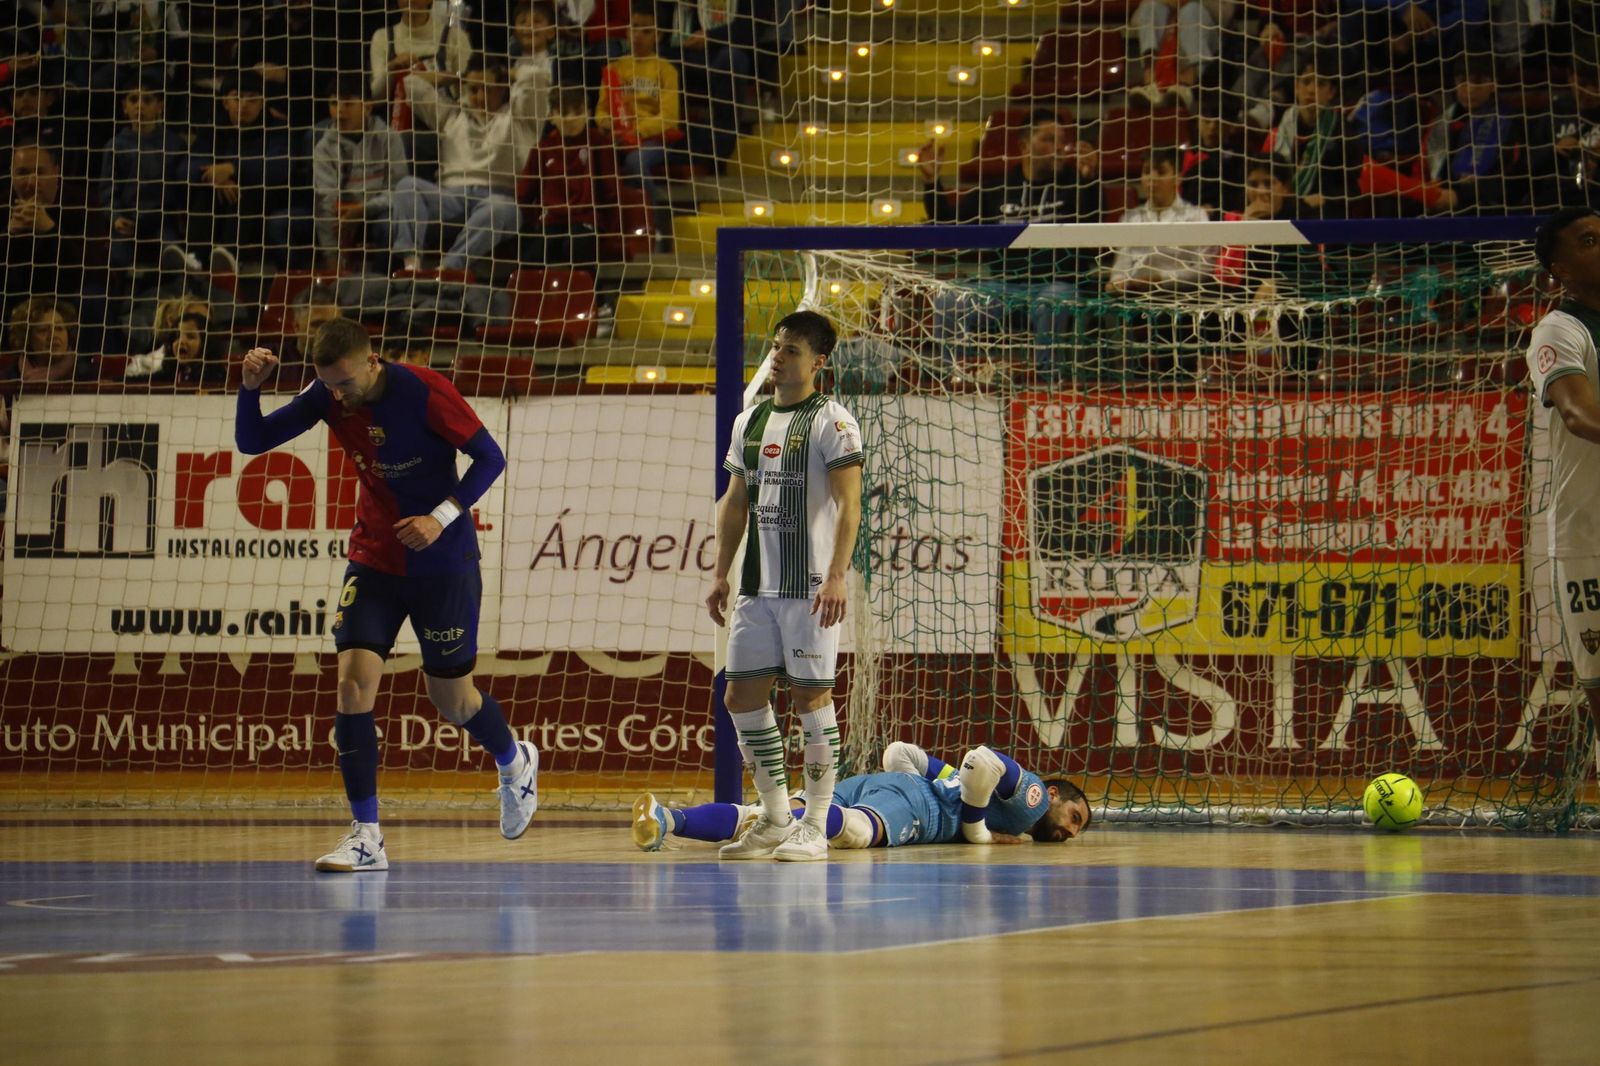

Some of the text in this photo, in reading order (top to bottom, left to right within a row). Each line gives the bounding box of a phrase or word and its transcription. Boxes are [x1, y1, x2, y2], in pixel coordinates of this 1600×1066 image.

[1485, 404, 1509, 438] 4
[168, 538, 319, 558] INSTALACIONES
[1044, 567, 1190, 593] RUTA
[1566, 578, 1600, 613] 25
[0, 717, 76, 751] uto
[91, 714, 312, 761] Municipal
[400, 714, 604, 762] Deprtes
